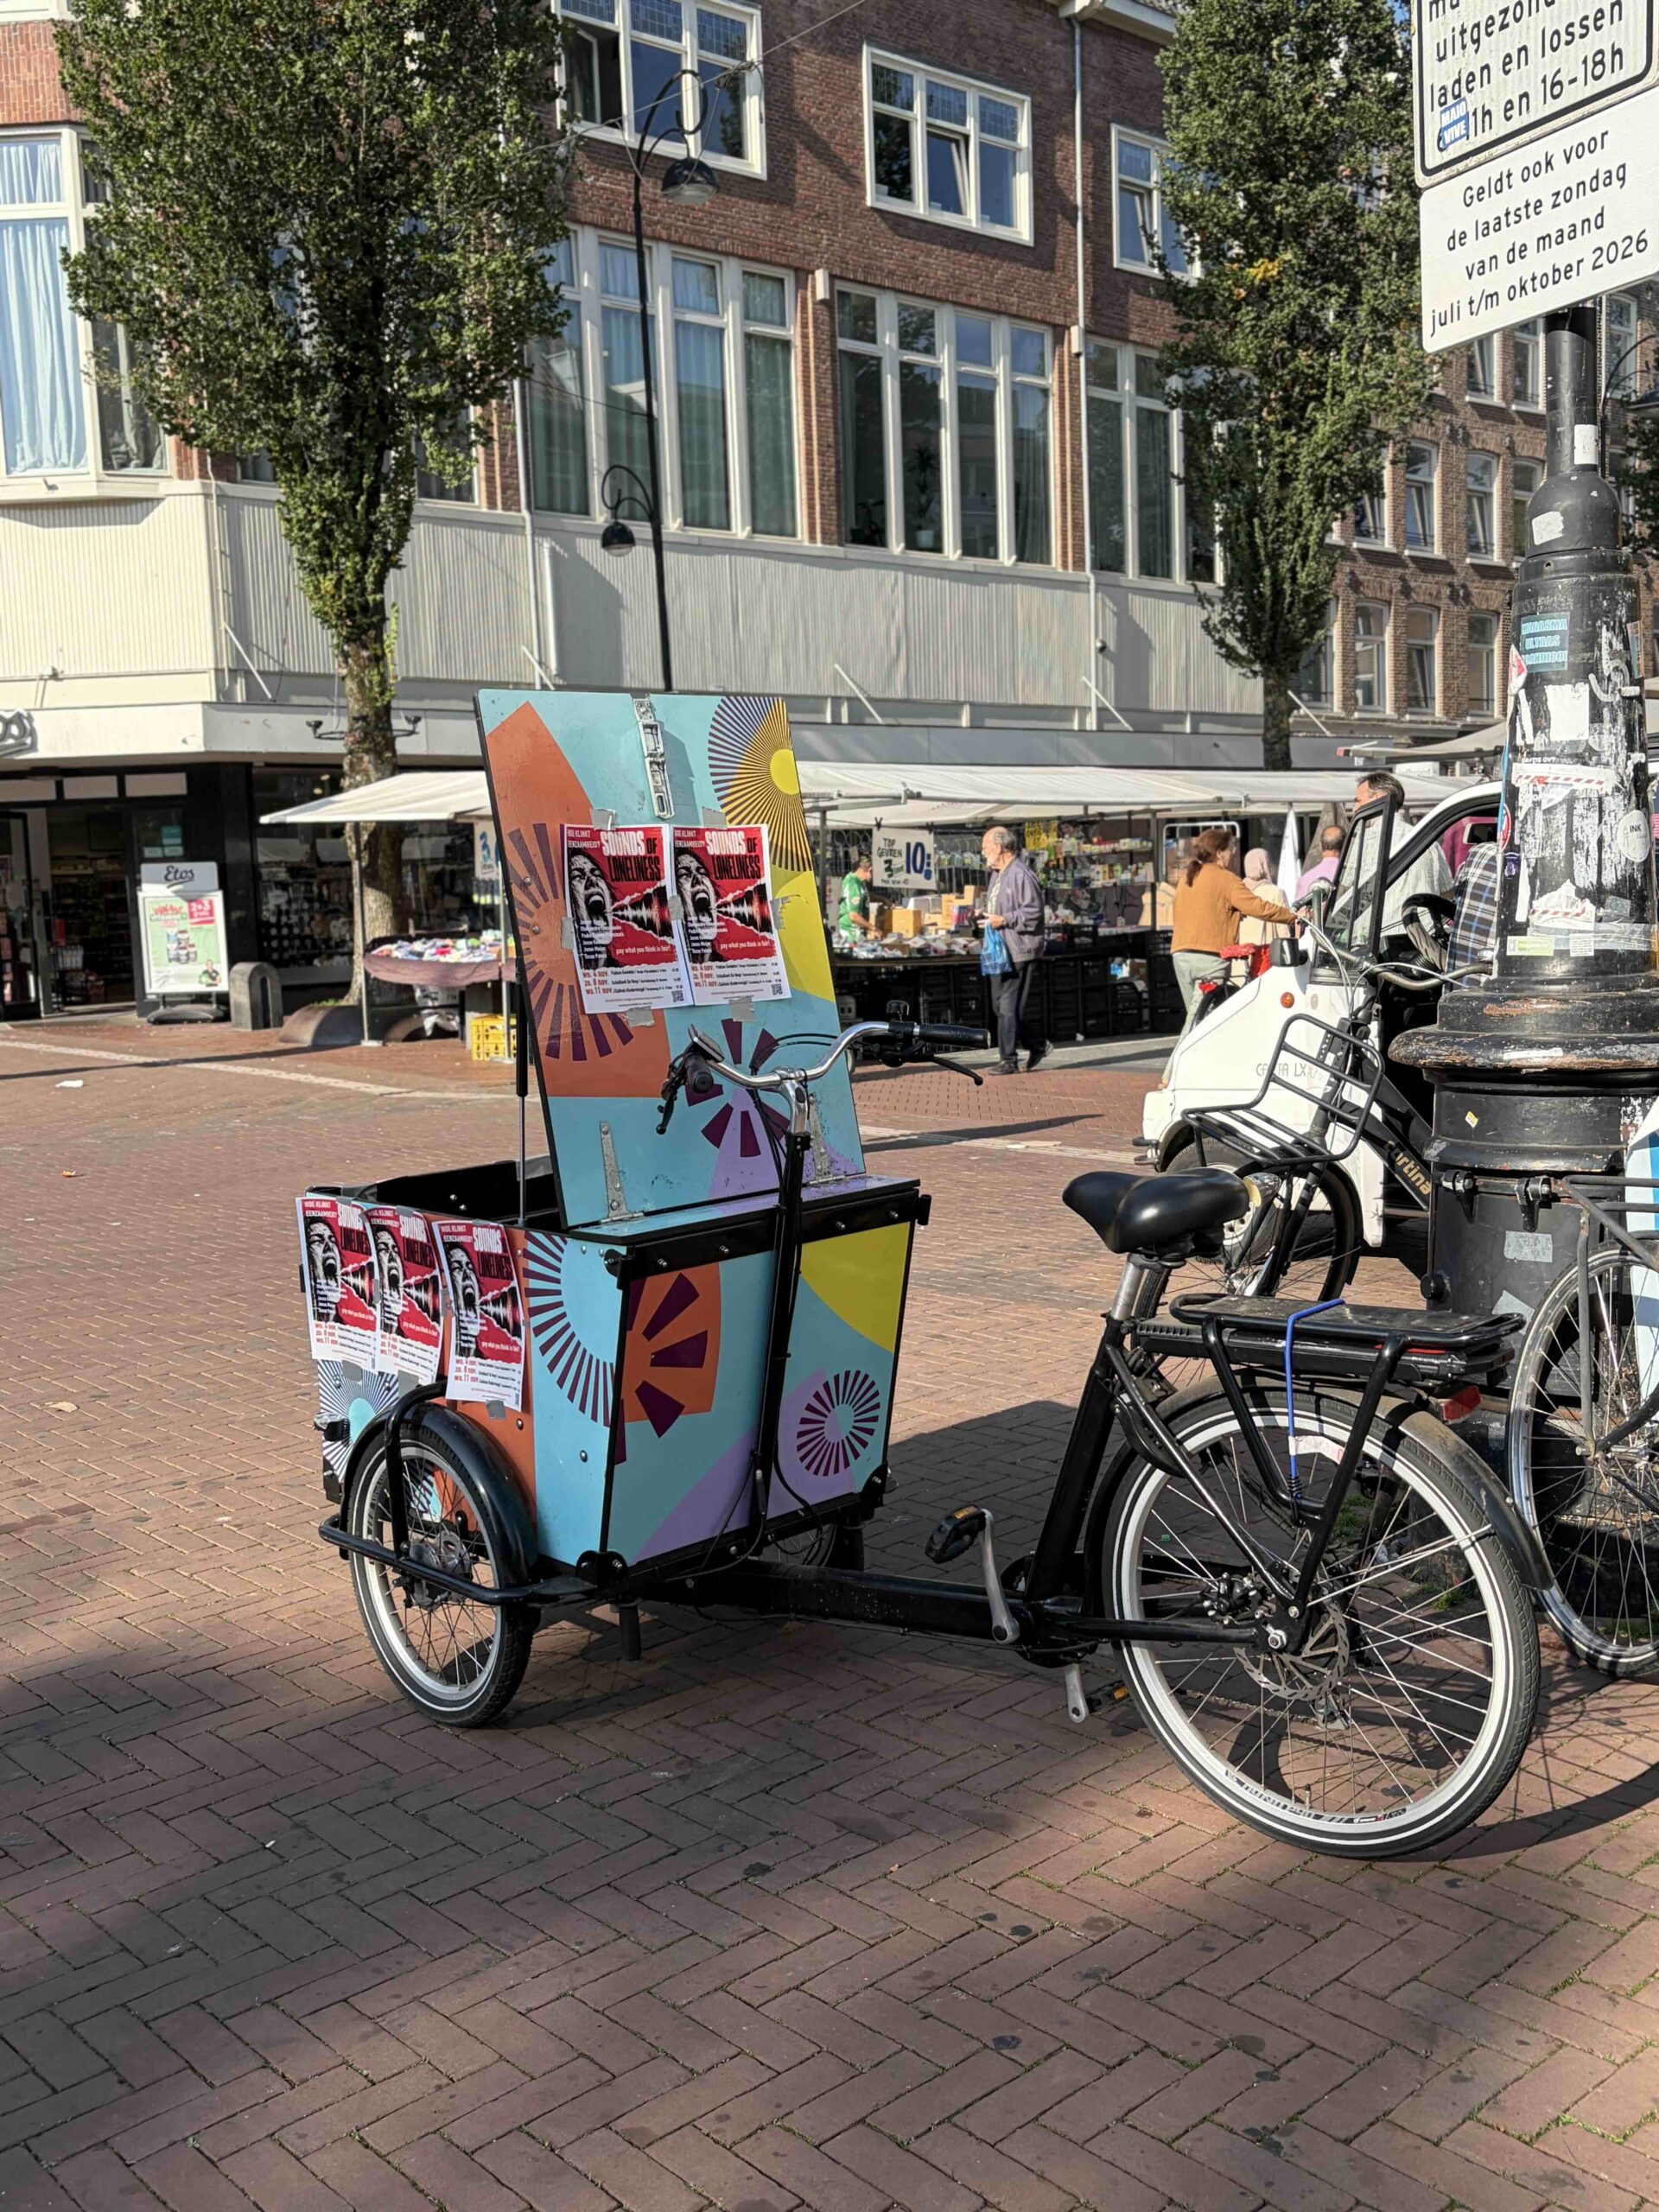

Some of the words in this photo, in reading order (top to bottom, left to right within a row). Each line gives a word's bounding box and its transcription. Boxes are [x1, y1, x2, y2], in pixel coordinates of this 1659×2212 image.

[1430, 63, 1491, 112] laden
[1502, 44, 1529, 76] en
[1541, 0, 1623, 59] lossen
[1503, 91, 1530, 122] en
[1541, 41, 1624, 105] 16-18h
[1443, 118, 1467, 145] VIVE
[1463, 168, 1514, 208] Geldt
[1521, 150, 1554, 183] ook
[1563, 130, 1609, 165] voor
[1447, 229, 1467, 251] de
[1474, 198, 1543, 241] laatste
[1551, 162, 1626, 210] zondag
[1465, 253, 1498, 281] van
[1506, 241, 1528, 265] de
[1536, 206, 1605, 253] maand
[1431, 299, 1461, 337] juli
[1468, 289, 1500, 317] t/m
[1507, 257, 1585, 302] oktober
[1592, 228, 1649, 271] 2026
[1630, 824, 1642, 833] INK
[600, 830, 645, 856] SOUNDS
[645, 837, 658, 855] OF
[704, 831, 746, 855] SOUNDS
[746, 837, 757, 854] OF
[163, 865, 195, 883] Etos
[607, 855, 661, 882] LONELINESS
[711, 855, 760, 880] LONELINESS
[884, 859, 893, 878] 3
[1294, 1063, 1306, 1077] LX
[338, 1204, 364, 1230] SOUNDS
[399, 1215, 427, 1243] SOUNDS
[473, 1227, 503, 1254] SOUNDS
